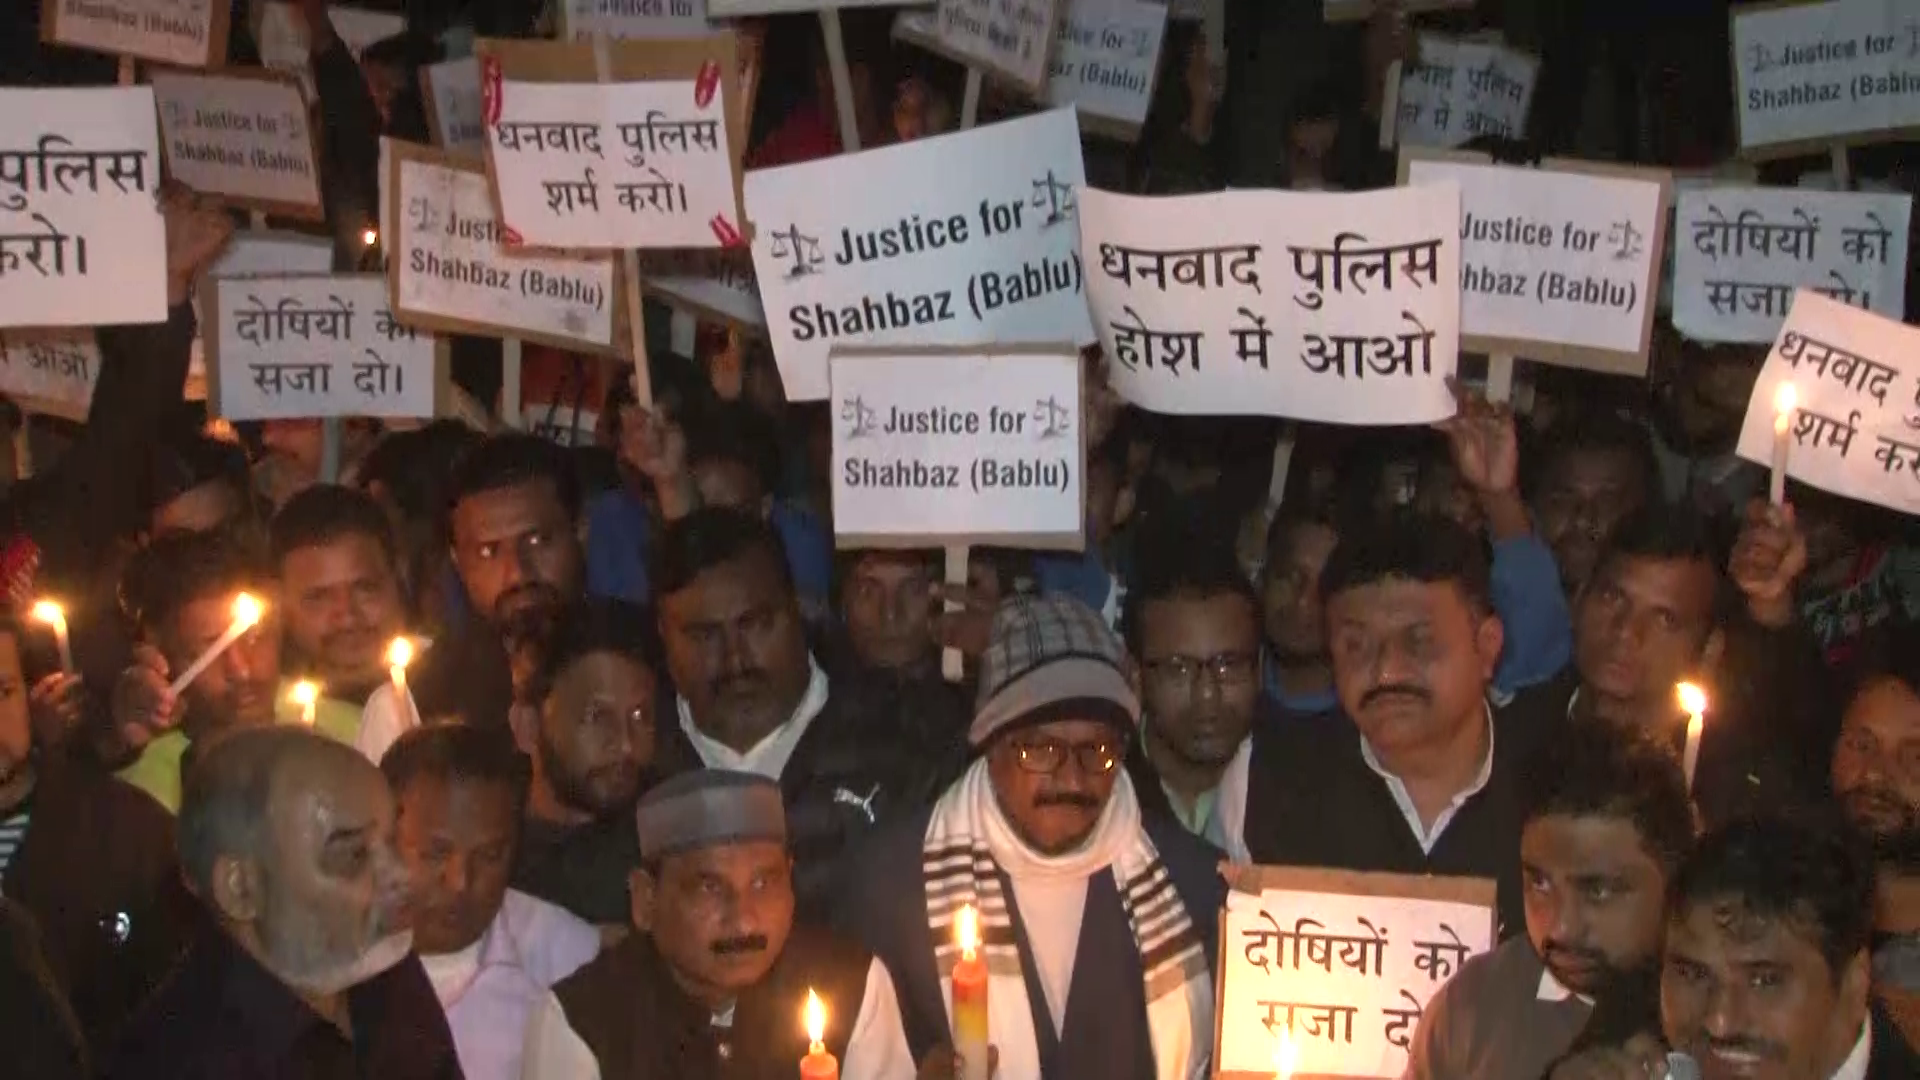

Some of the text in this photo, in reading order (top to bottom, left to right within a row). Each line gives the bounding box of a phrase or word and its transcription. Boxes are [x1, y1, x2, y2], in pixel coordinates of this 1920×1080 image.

[1782, 34, 1896, 67] Justice for
[1080, 62, 1147, 95] (Bablu)
[1748, 82, 1842, 112] Shahbaz
[616, 110, 719, 167] पुलिस
[542, 167, 600, 216] शर्म
[834, 199, 1025, 266] Justice for
[1459, 211, 1600, 252] Justice for
[1691, 204, 1894, 266] दोषियों को
[410, 247, 605, 313] Shahbaz (Bablu)
[1286, 231, 1444, 311] पुलिस
[1536, 268, 1638, 315] (Bablu)
[233, 294, 355, 342] दोषियों
[788, 253, 1082, 342] Shahbaz (Bablu)
[1109, 305, 1437, 379] होश में आओ
[249, 362, 332, 395] सजा
[884, 406, 1027, 435] Justice for
[1793, 407, 1863, 459] शर्म
[844, 457, 1070, 494] Shahbaz (Bablu)
[1241, 910, 1389, 978] दोषियों
